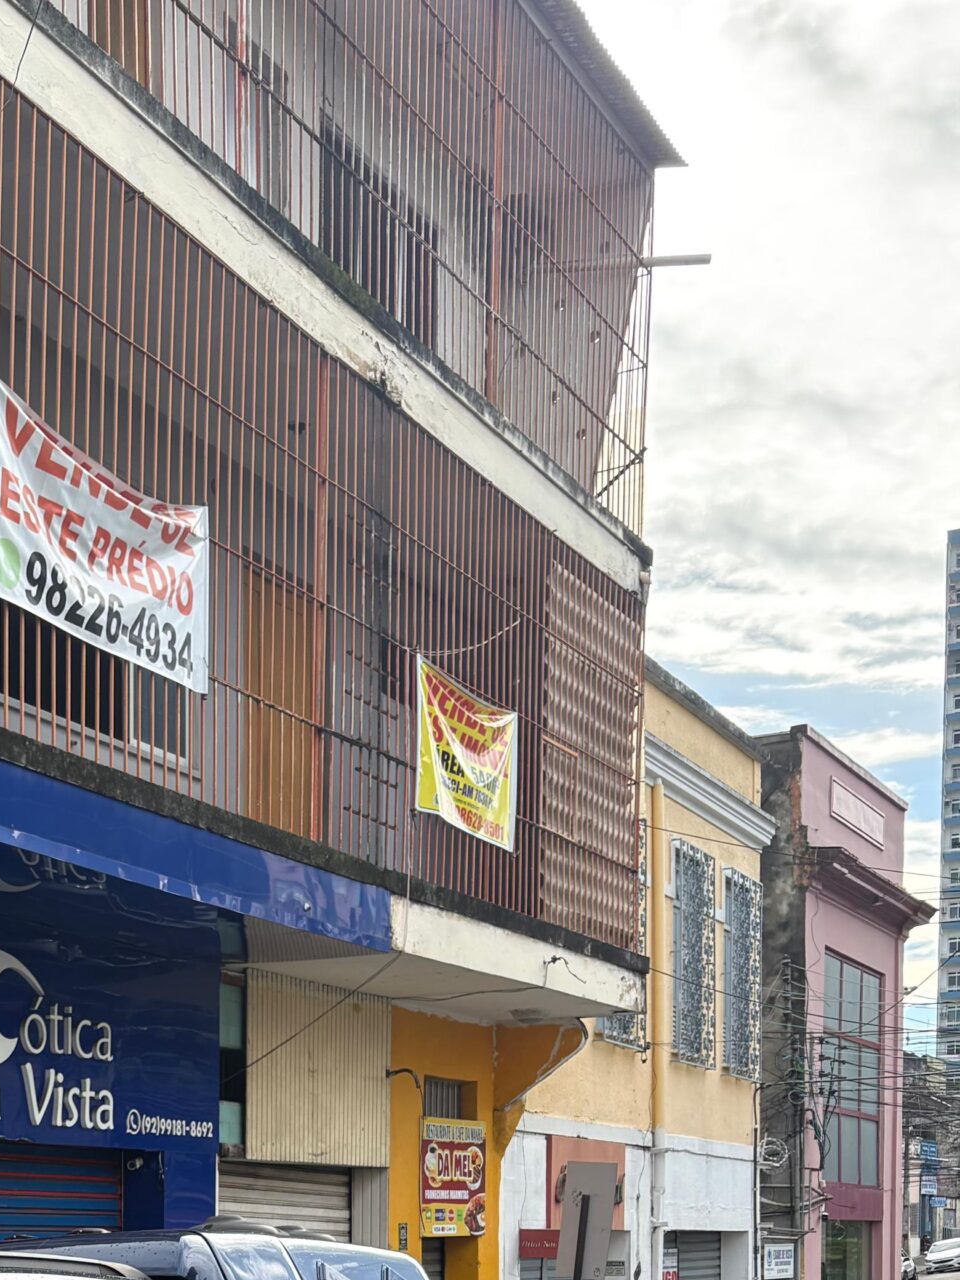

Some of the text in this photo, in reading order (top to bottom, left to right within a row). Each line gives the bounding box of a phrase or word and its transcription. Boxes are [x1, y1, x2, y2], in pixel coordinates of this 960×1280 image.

[0, 467, 194, 617] ESTE PRÉDIO
[25, 551, 194, 681] 98226-4934
[20, 996, 114, 1062] ótica
[21, 1062, 114, 1130] Vista
[437, 1152, 473, 1178] DA MEL
